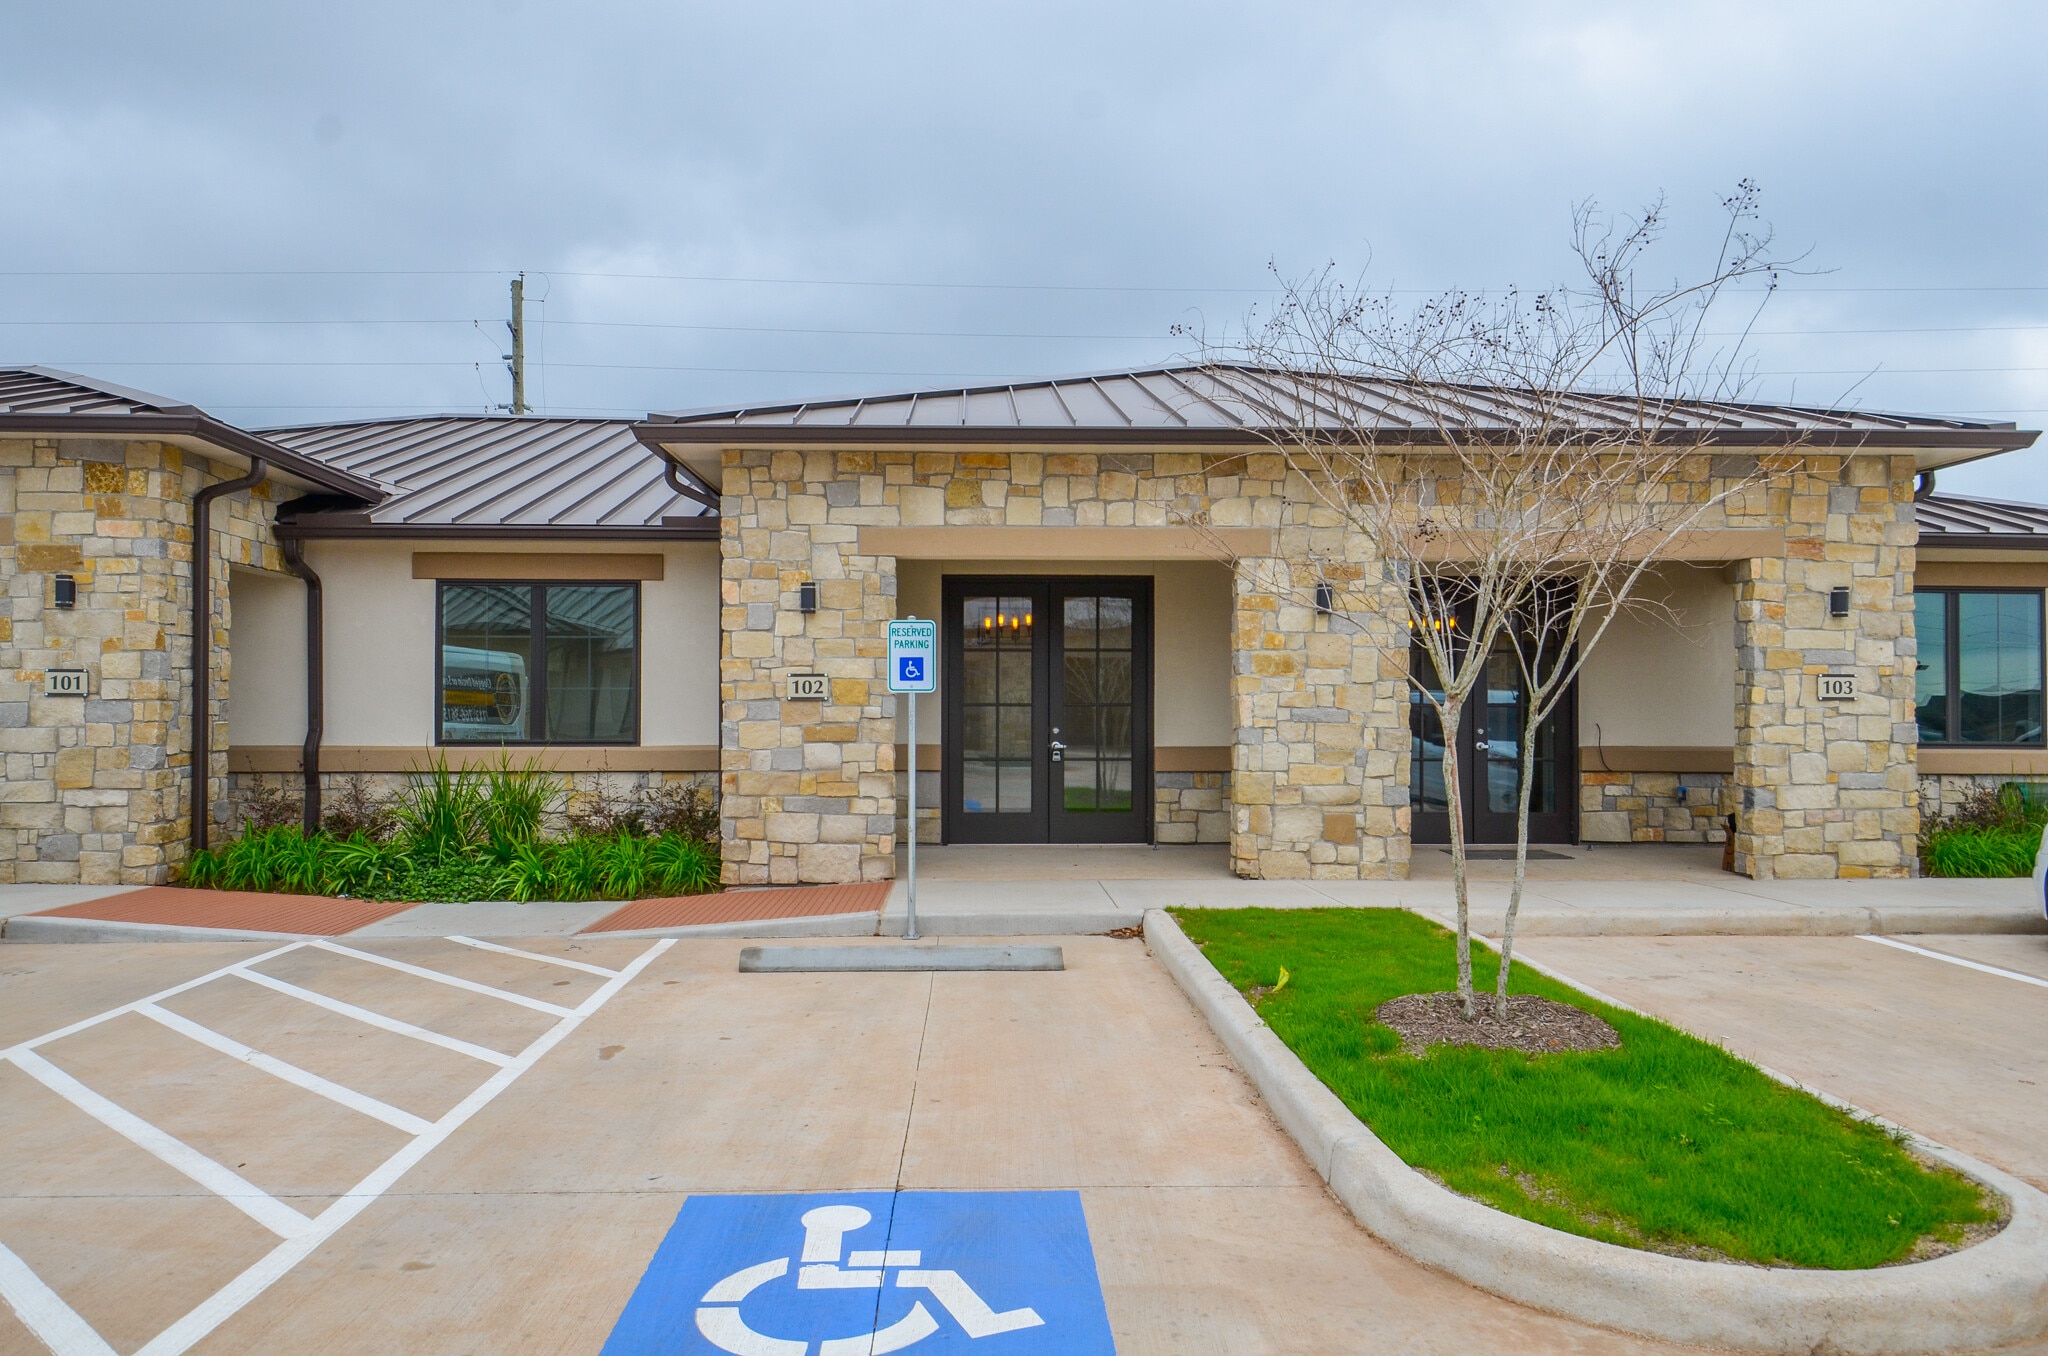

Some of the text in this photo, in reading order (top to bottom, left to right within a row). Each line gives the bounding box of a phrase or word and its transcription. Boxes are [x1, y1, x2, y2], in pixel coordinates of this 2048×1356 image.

[891, 628, 931, 636] RESERVED
[894, 640, 929, 649] PARKING
[50, 675, 81, 690] 101
[792, 680, 824, 695] 102
[1823, 680, 1853, 695] 103
